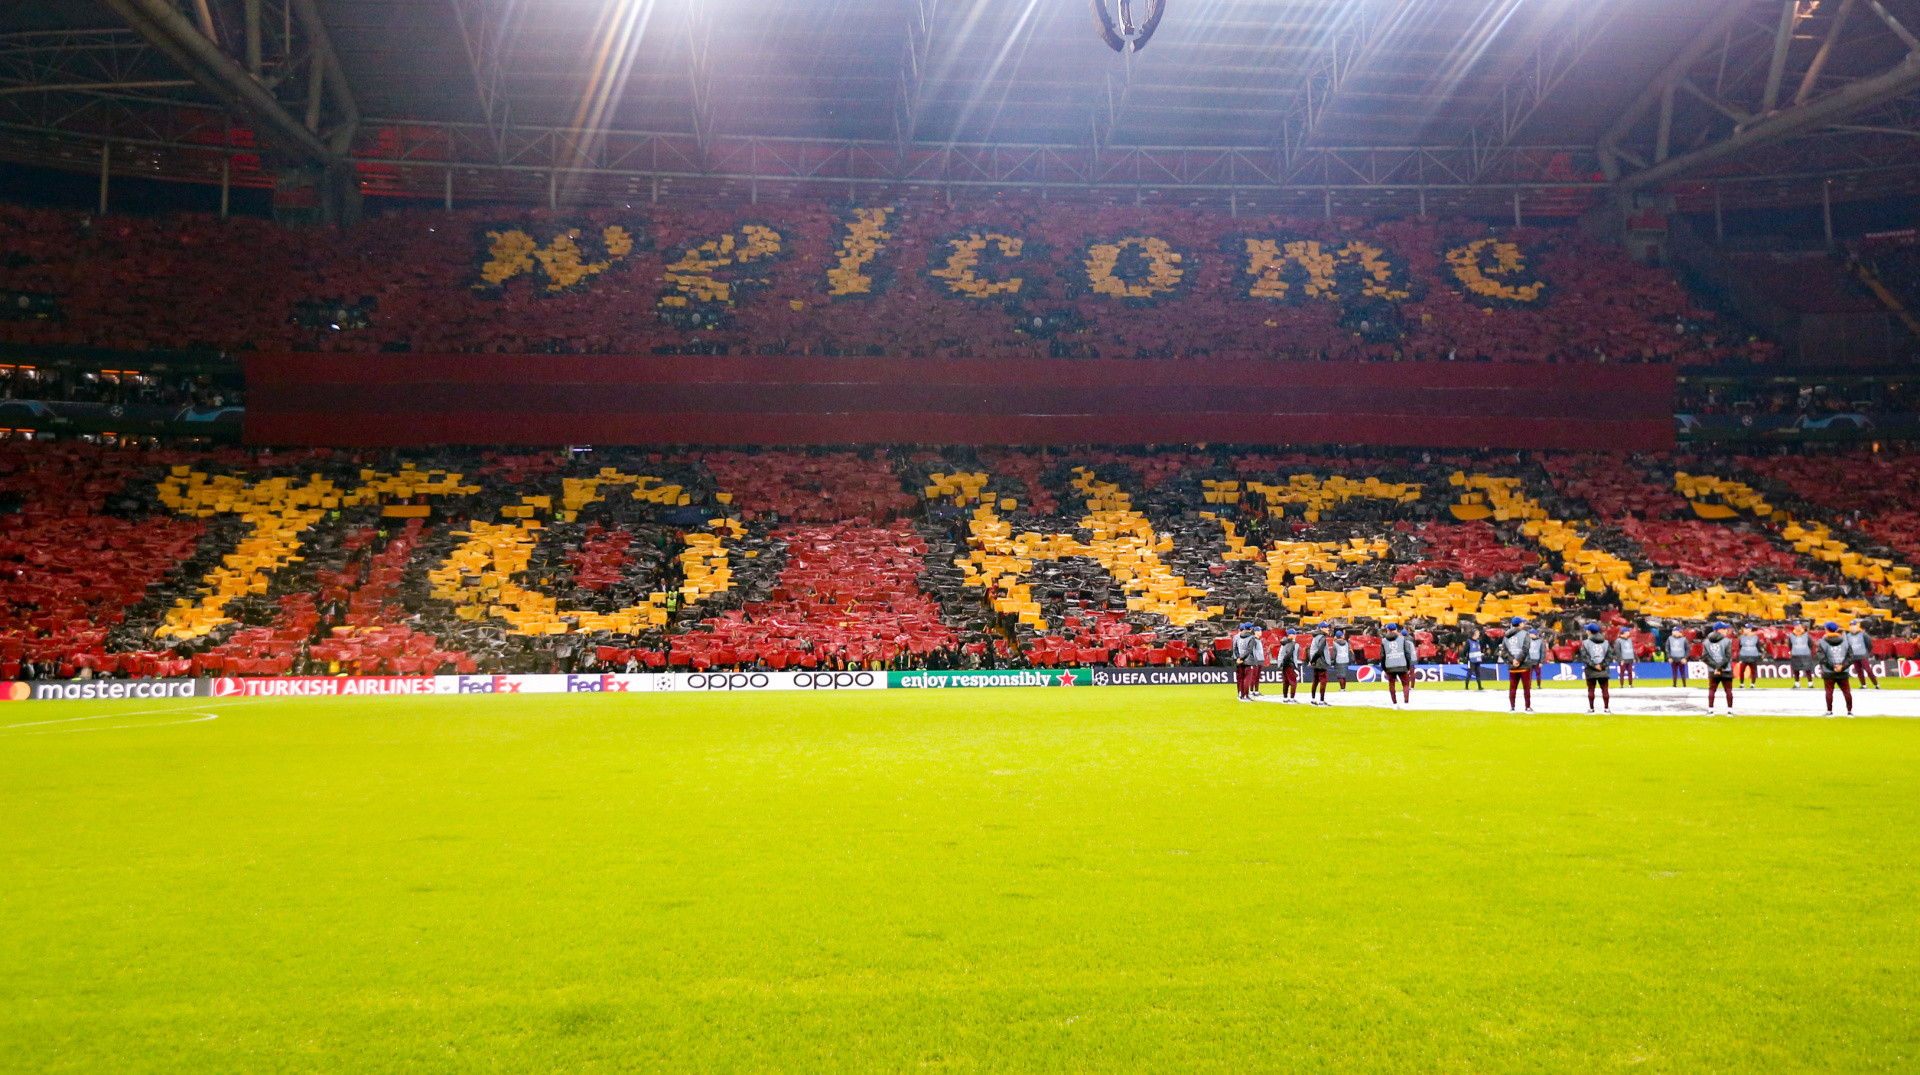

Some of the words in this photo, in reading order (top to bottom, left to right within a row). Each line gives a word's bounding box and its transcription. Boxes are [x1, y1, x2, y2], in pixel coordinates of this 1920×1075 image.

[154, 462, 748, 639] TO
[246, 679, 337, 696] TURKISH
[342, 677, 435, 695] AIRLINES
[458, 675, 523, 694] FedEx
[566, 674, 630, 693] FedEx
[901, 672, 948, 688] enjoy
[951, 671, 1051, 688] responsibly
[1112, 672, 1147, 684] UEFA
[1150, 671, 1229, 684] CHAMPIONS
[1234, 670, 1284, 683] LGUE
[37, 679, 196, 699] mastercard
